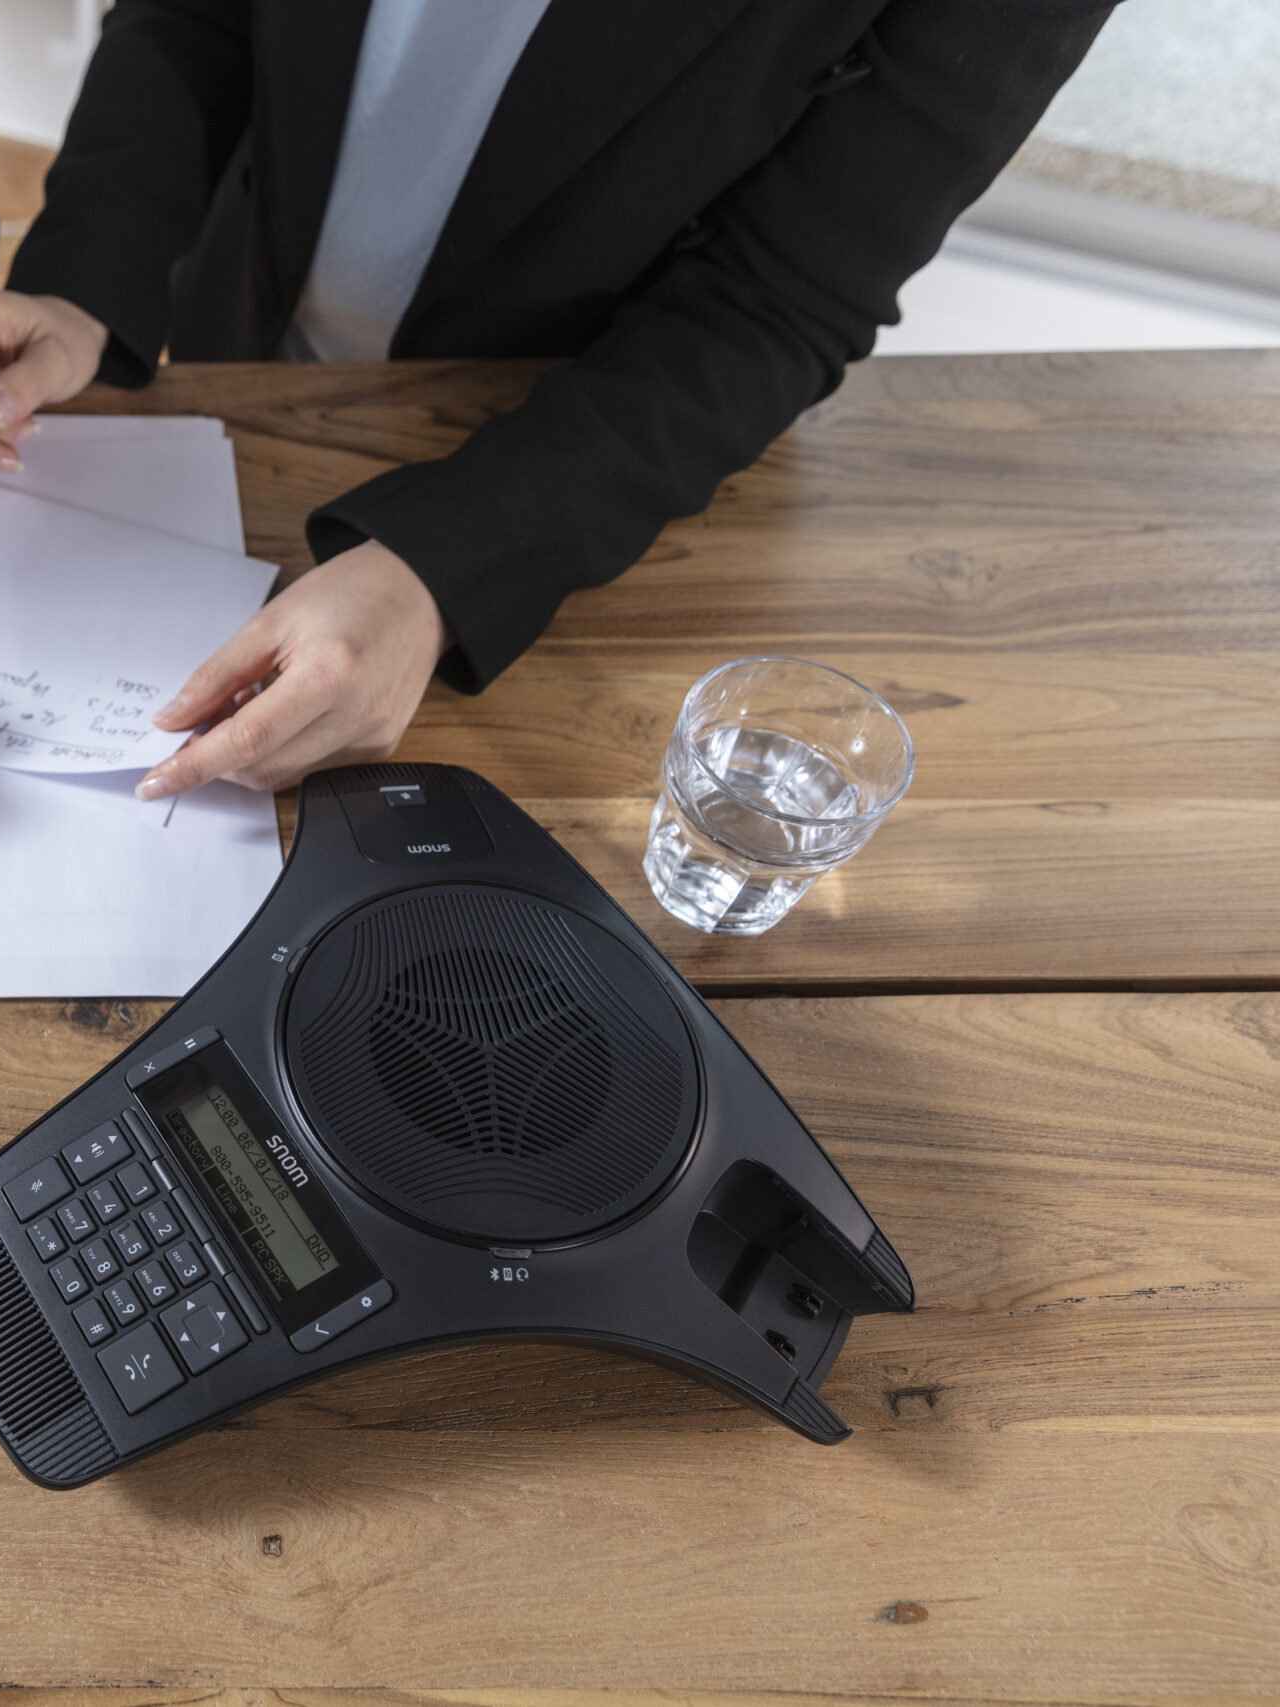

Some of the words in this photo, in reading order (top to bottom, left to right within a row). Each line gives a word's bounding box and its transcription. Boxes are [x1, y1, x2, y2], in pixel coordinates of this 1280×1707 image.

[407, 843, 452, 854] snom
[169, 1110, 210, 1169] Directory
[266, 1134, 309, 1188] snom
[213, 1094, 239, 1128] 12:00
[238, 1132, 289, 1200] 06/01/18
[306, 1234, 331, 1264] DND
[136, 1186, 149, 1196] 1
[211, 1145, 275, 1238] 800-595-9511
[215, 1184, 238, 1214] Line
[104, 1203, 116, 1214] 4
[148, 1211, 158, 1224] ABC
[74, 1220, 88, 1230] 7
[158, 1224, 172, 1237] 2
[119, 1233, 128, 1245] JKL
[128, 1242, 142, 1255] 5
[172, 1251, 183, 1264] DEF
[97, 1261, 111, 1273] 8
[184, 1265, 197, 1277] 3
[141, 1270, 152, 1284] MNO
[111, 1289, 123, 1306] WXYZ
[153, 1286, 167, 1296] 6
[122, 1303, 136, 1314] 9
